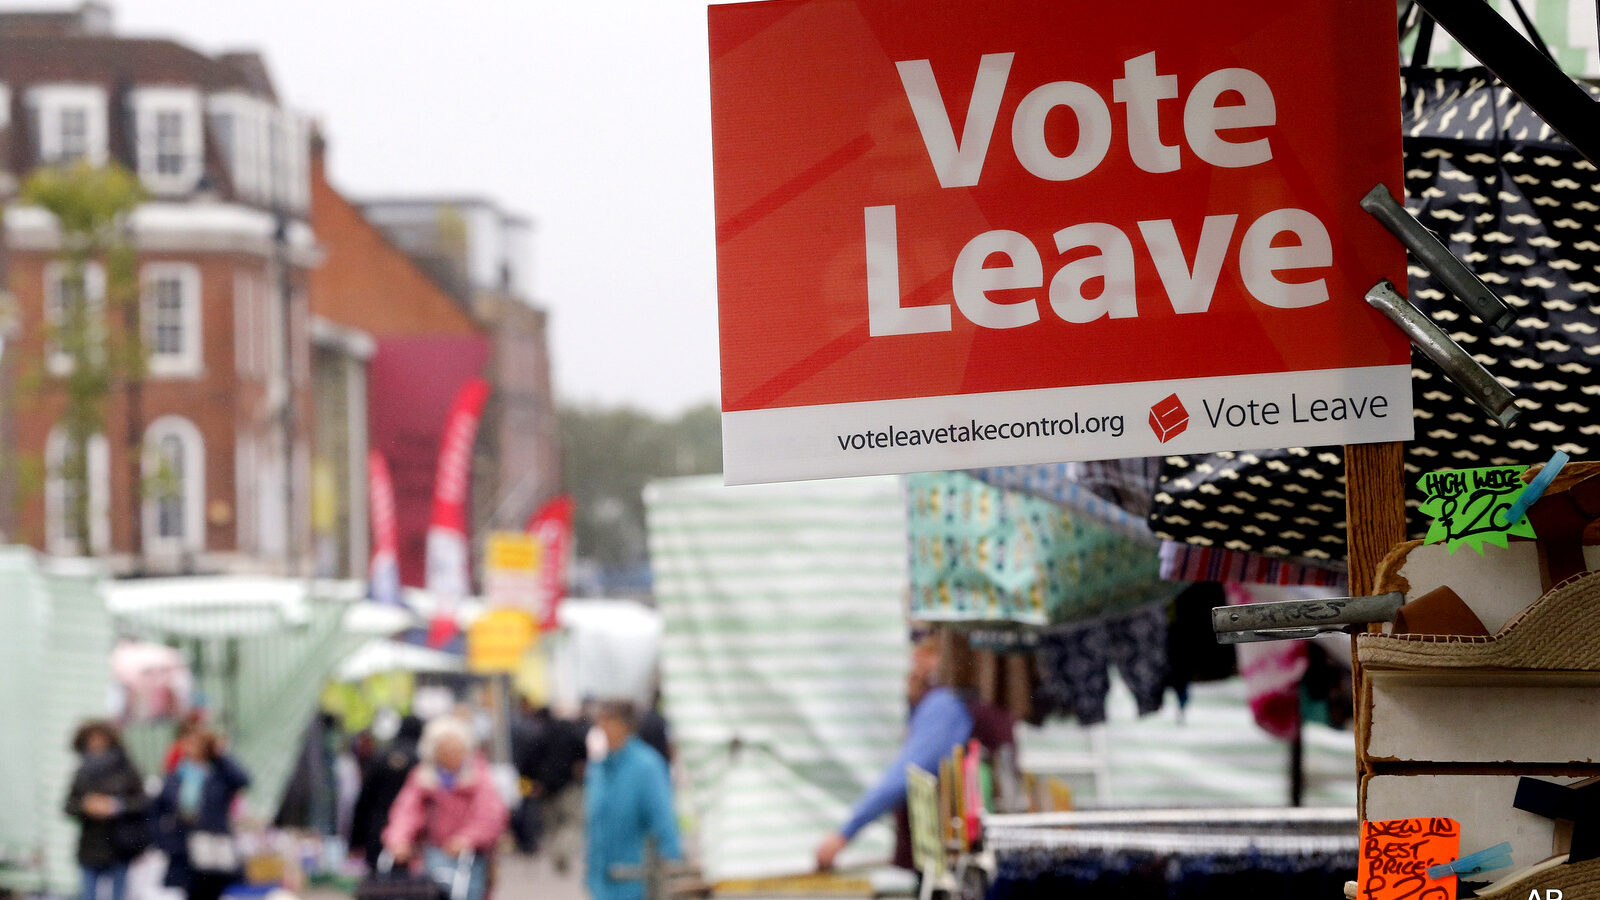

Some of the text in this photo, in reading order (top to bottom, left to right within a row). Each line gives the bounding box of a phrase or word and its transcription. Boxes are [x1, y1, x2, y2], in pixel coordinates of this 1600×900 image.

[895, 51, 1277, 189] Vote
[864, 204, 1333, 338] Leave
[1202, 393, 1389, 429] Vote Leave
[837, 411, 1125, 452] voteleavetakecontrol.org
[1426, 472, 1468, 495] HIGH
[1367, 817, 1453, 835] NEW IN
[1365, 838, 1430, 859] BEST
